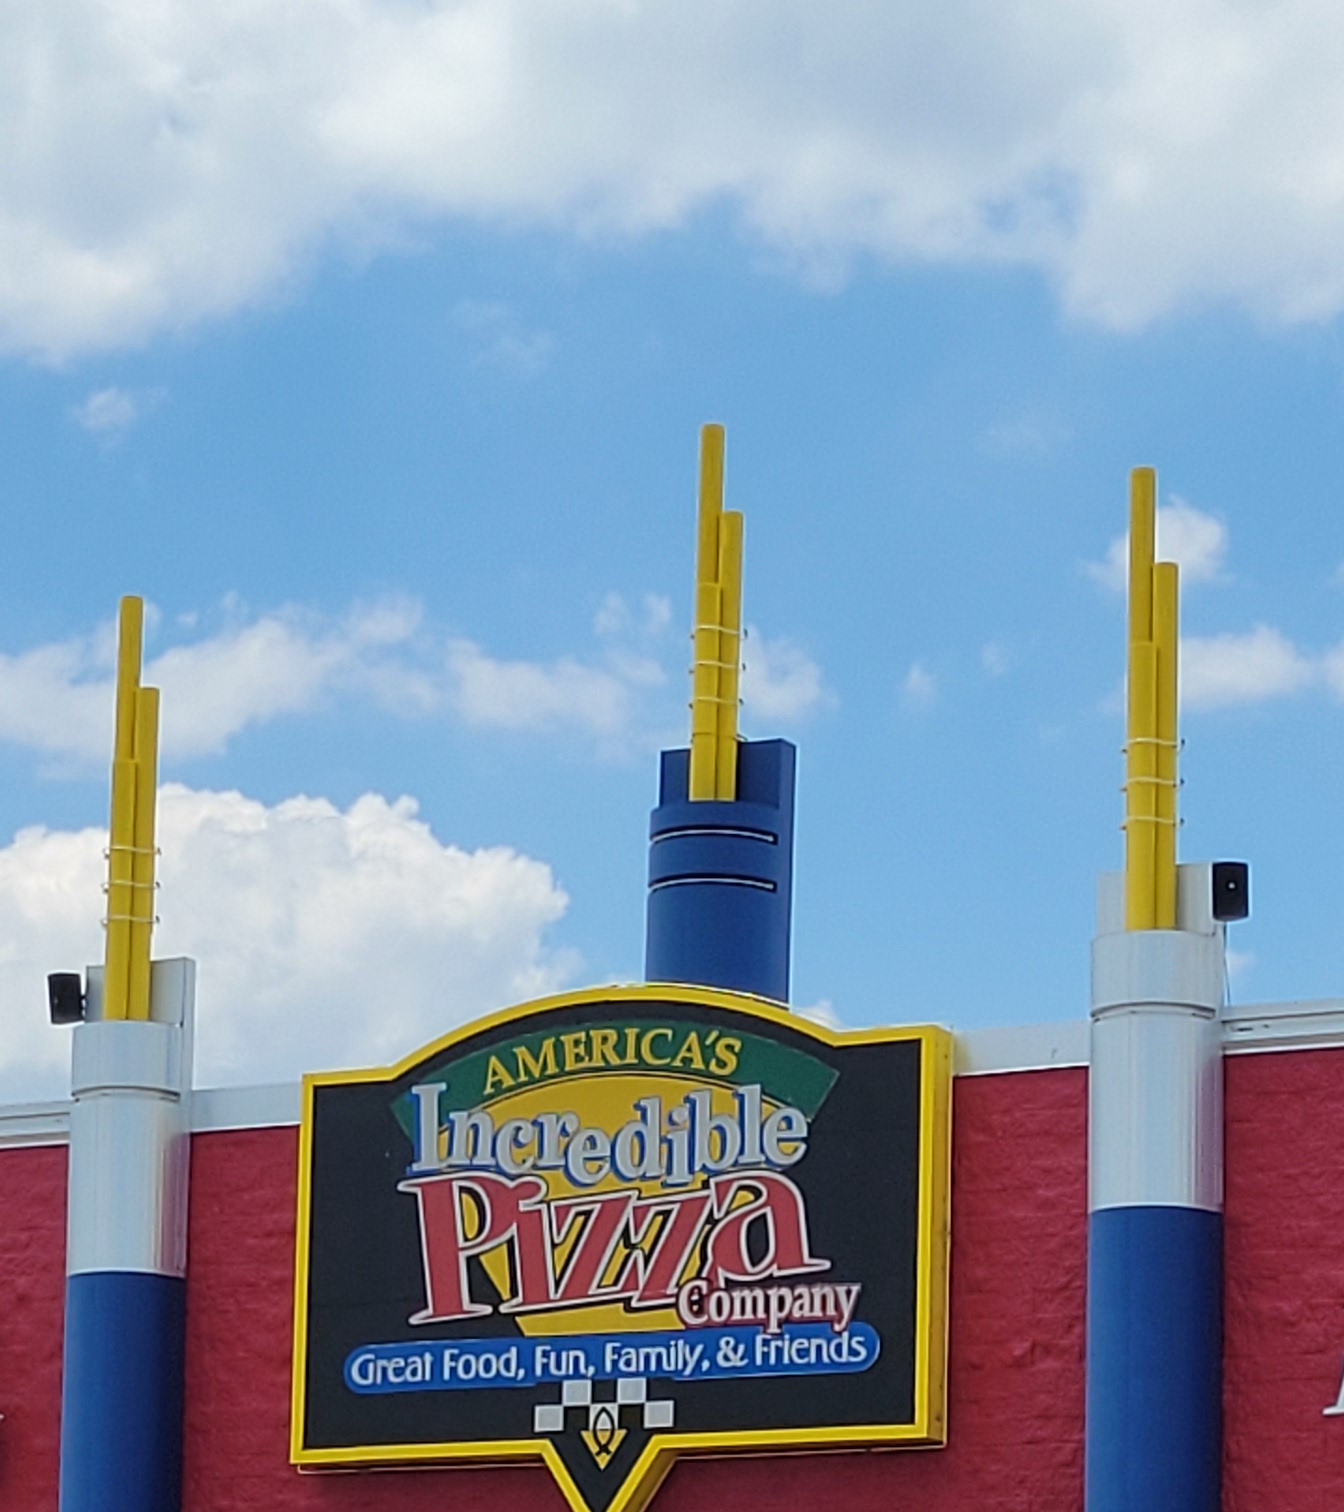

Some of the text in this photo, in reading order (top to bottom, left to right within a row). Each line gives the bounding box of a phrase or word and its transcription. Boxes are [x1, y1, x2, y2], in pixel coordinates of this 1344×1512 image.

[482, 1027, 742, 1095] AMERICA'S
[409, 1081, 810, 1187] Incredible
[397, 1170, 832, 1326] Pizza
[675, 1277, 862, 1336] Company
[350, 1329, 867, 1386] Great Food, Fun, Family, & Friends
